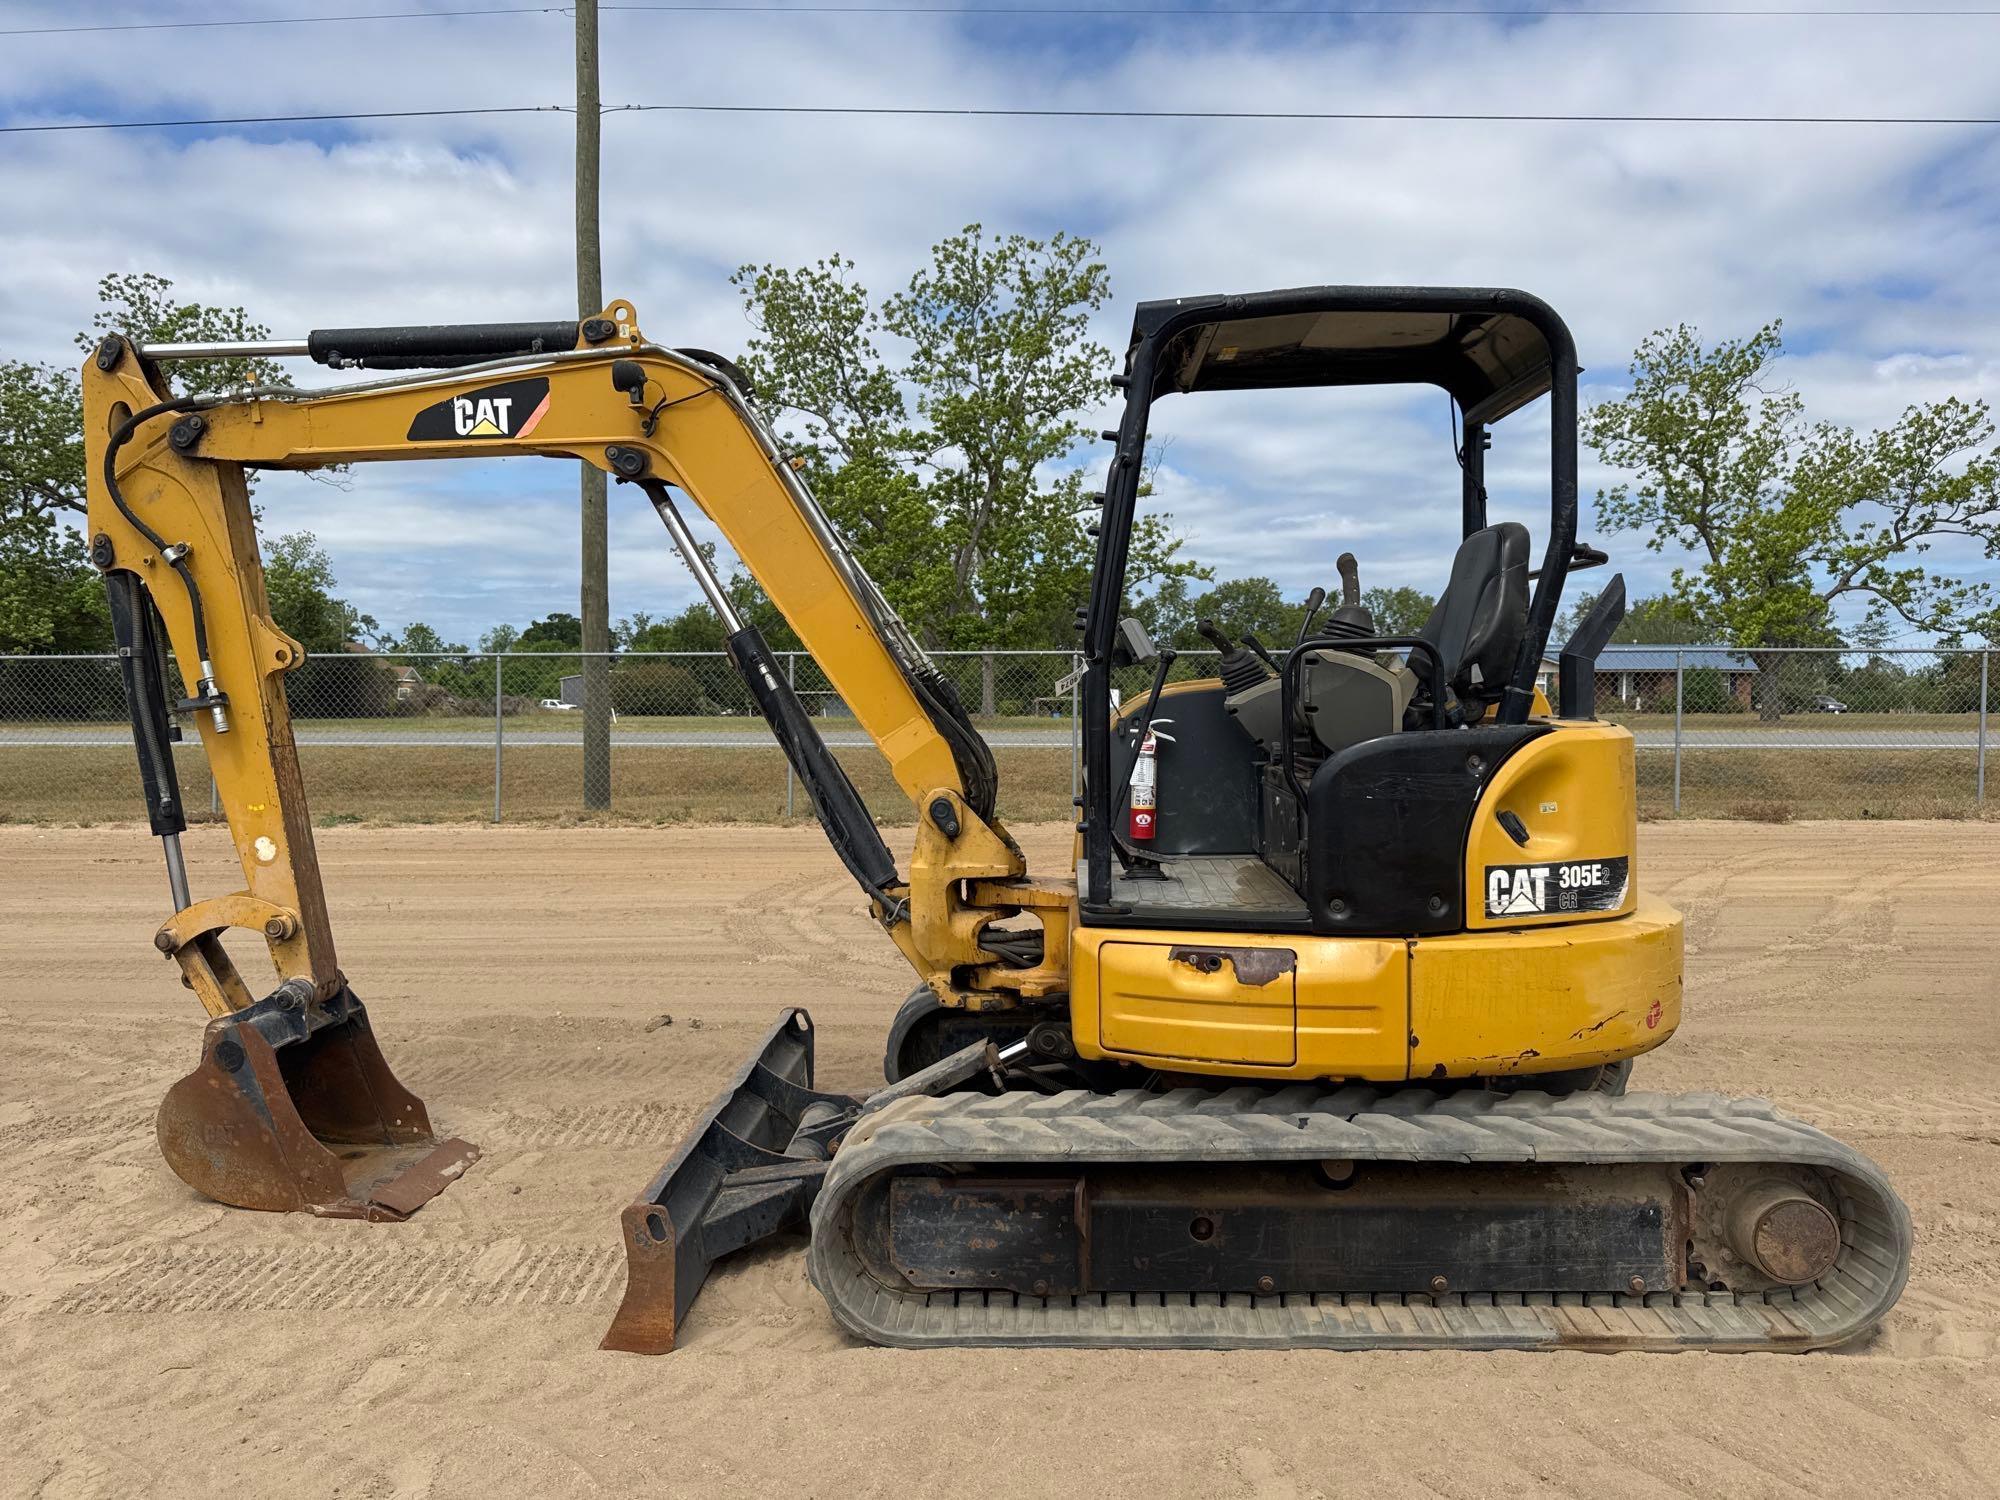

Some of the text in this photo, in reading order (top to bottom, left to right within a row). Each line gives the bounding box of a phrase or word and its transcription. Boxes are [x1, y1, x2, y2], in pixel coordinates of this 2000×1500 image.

[454, 396, 512, 435] CAT
[1489, 867, 1550, 914] CAT
[1559, 892, 1578, 909] CR
